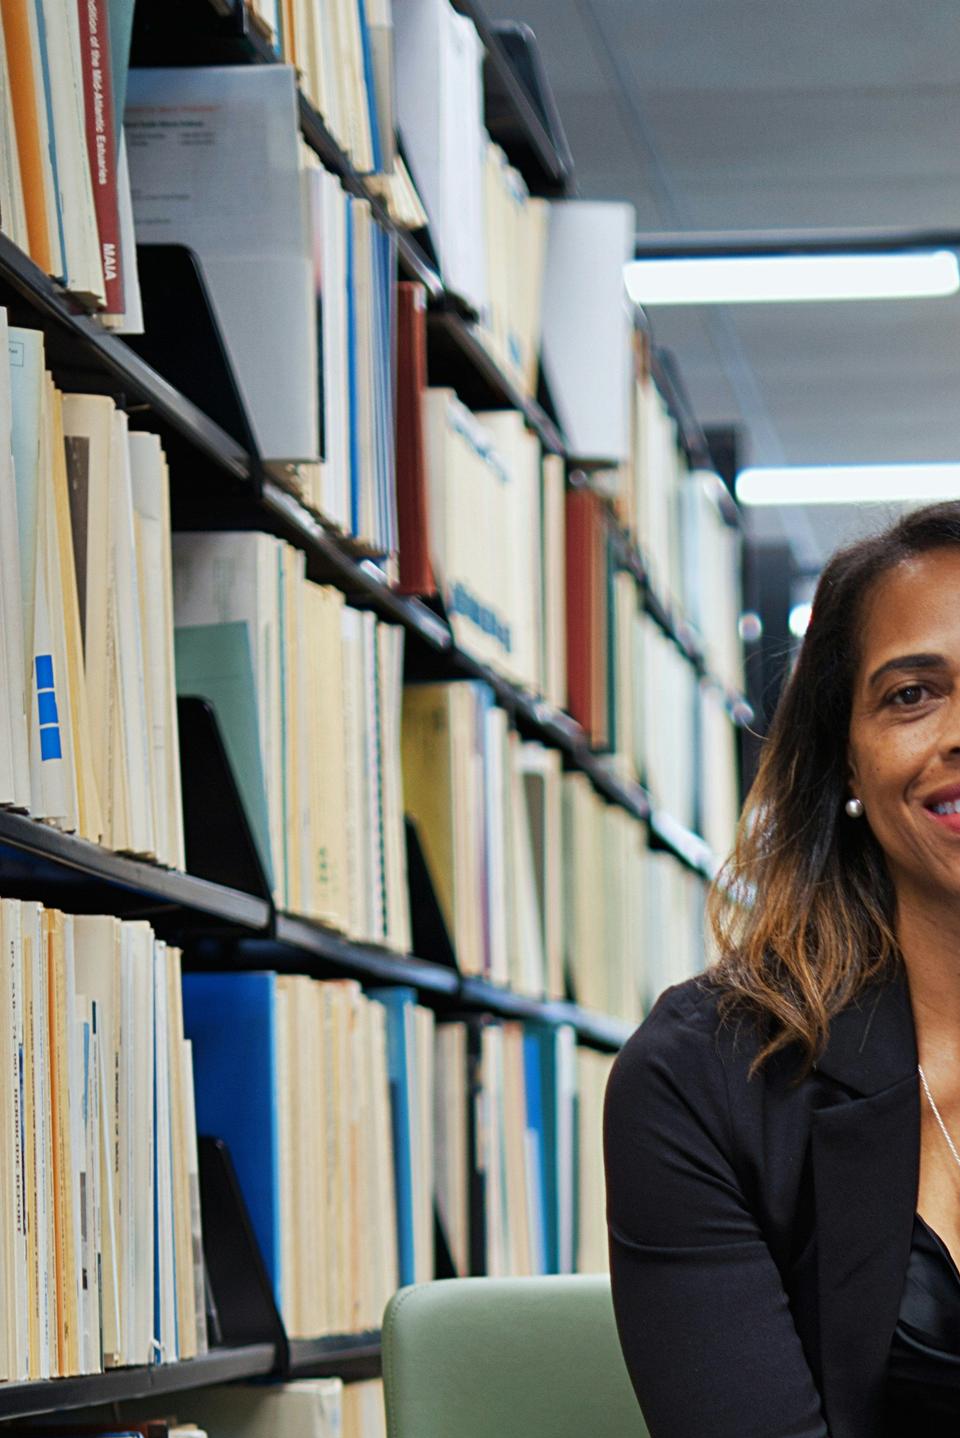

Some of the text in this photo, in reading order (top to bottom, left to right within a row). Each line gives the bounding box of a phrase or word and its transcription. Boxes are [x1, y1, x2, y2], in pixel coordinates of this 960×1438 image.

[90, 35, 100, 48] of
[91, 50, 101, 67] the
[92, 69, 105, 134] Mid-Atlantic
[97, 135, 108, 185] Estuaries
[102, 243, 117, 281] MAIA
